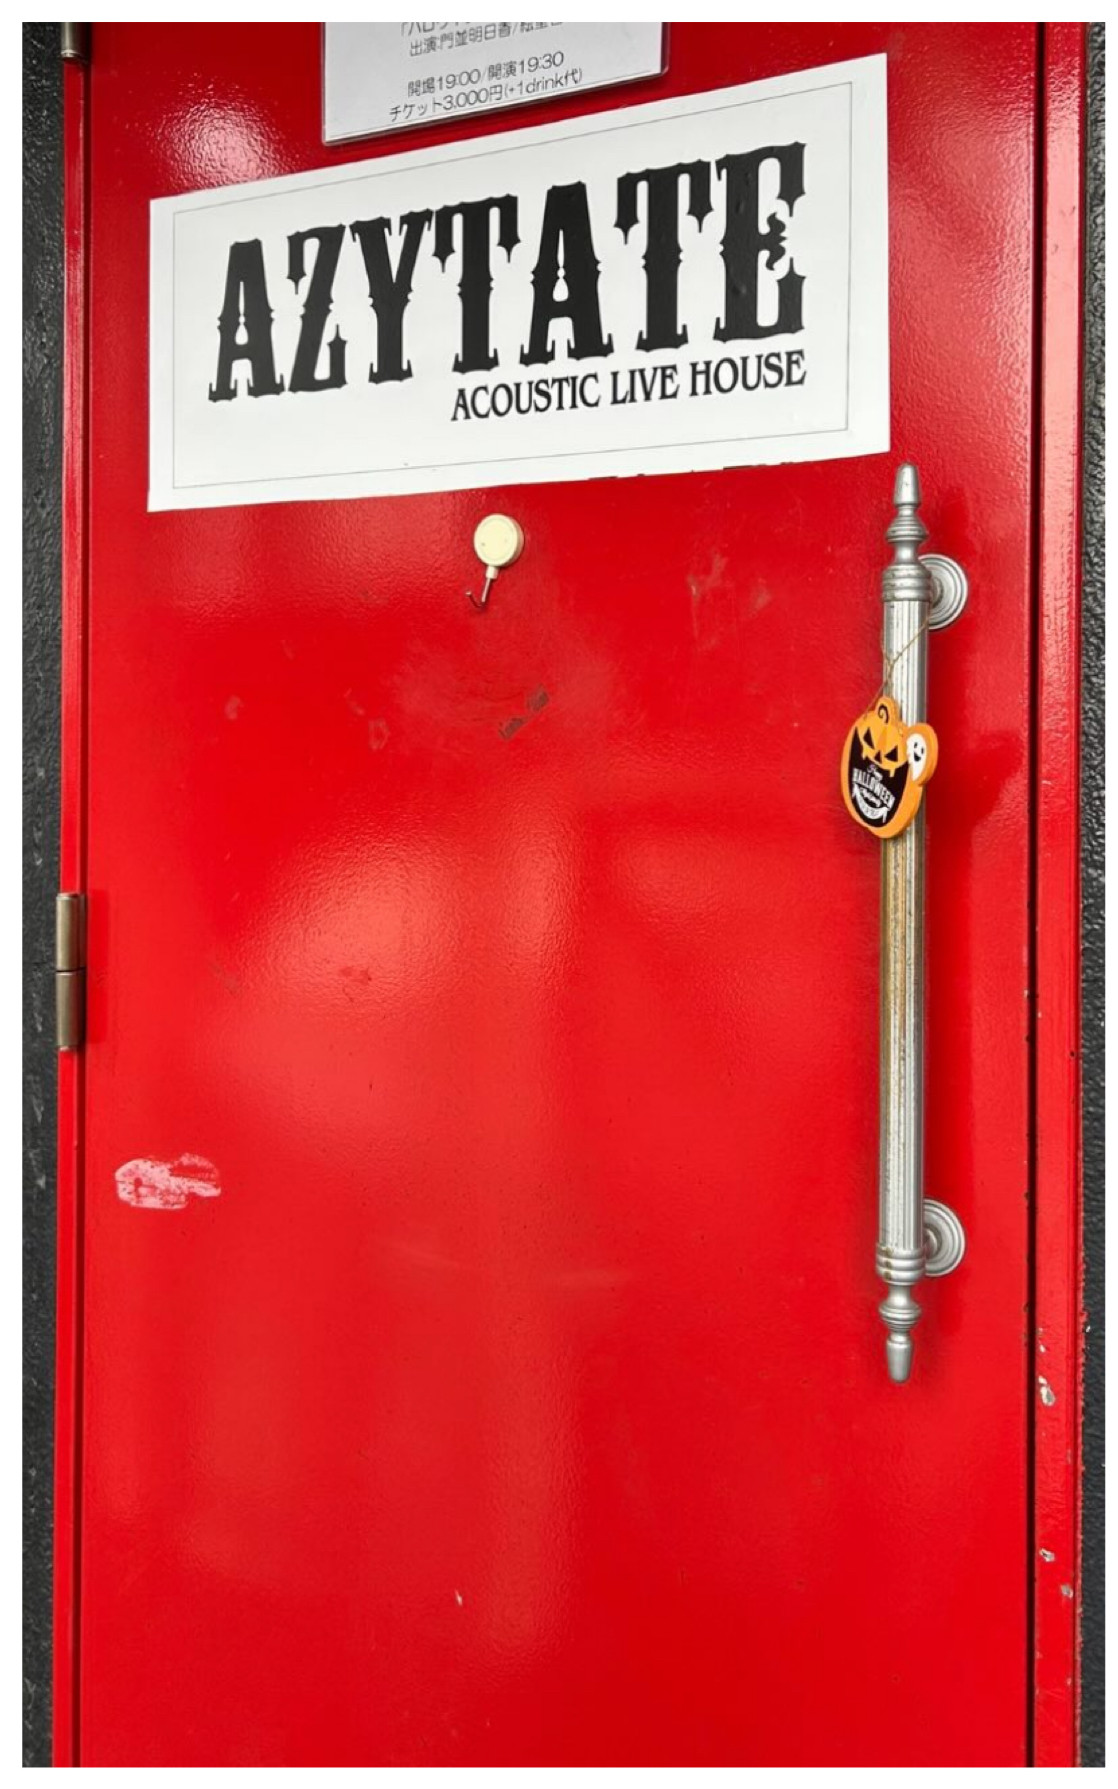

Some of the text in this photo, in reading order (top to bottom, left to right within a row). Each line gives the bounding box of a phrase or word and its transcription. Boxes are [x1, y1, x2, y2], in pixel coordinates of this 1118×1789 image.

[208, 141, 807, 403] AZYTATE
[451, 349, 807, 422] ACOUSTIC LIVE HOUSE
[852, 767, 896, 811] HALLOWEEN
